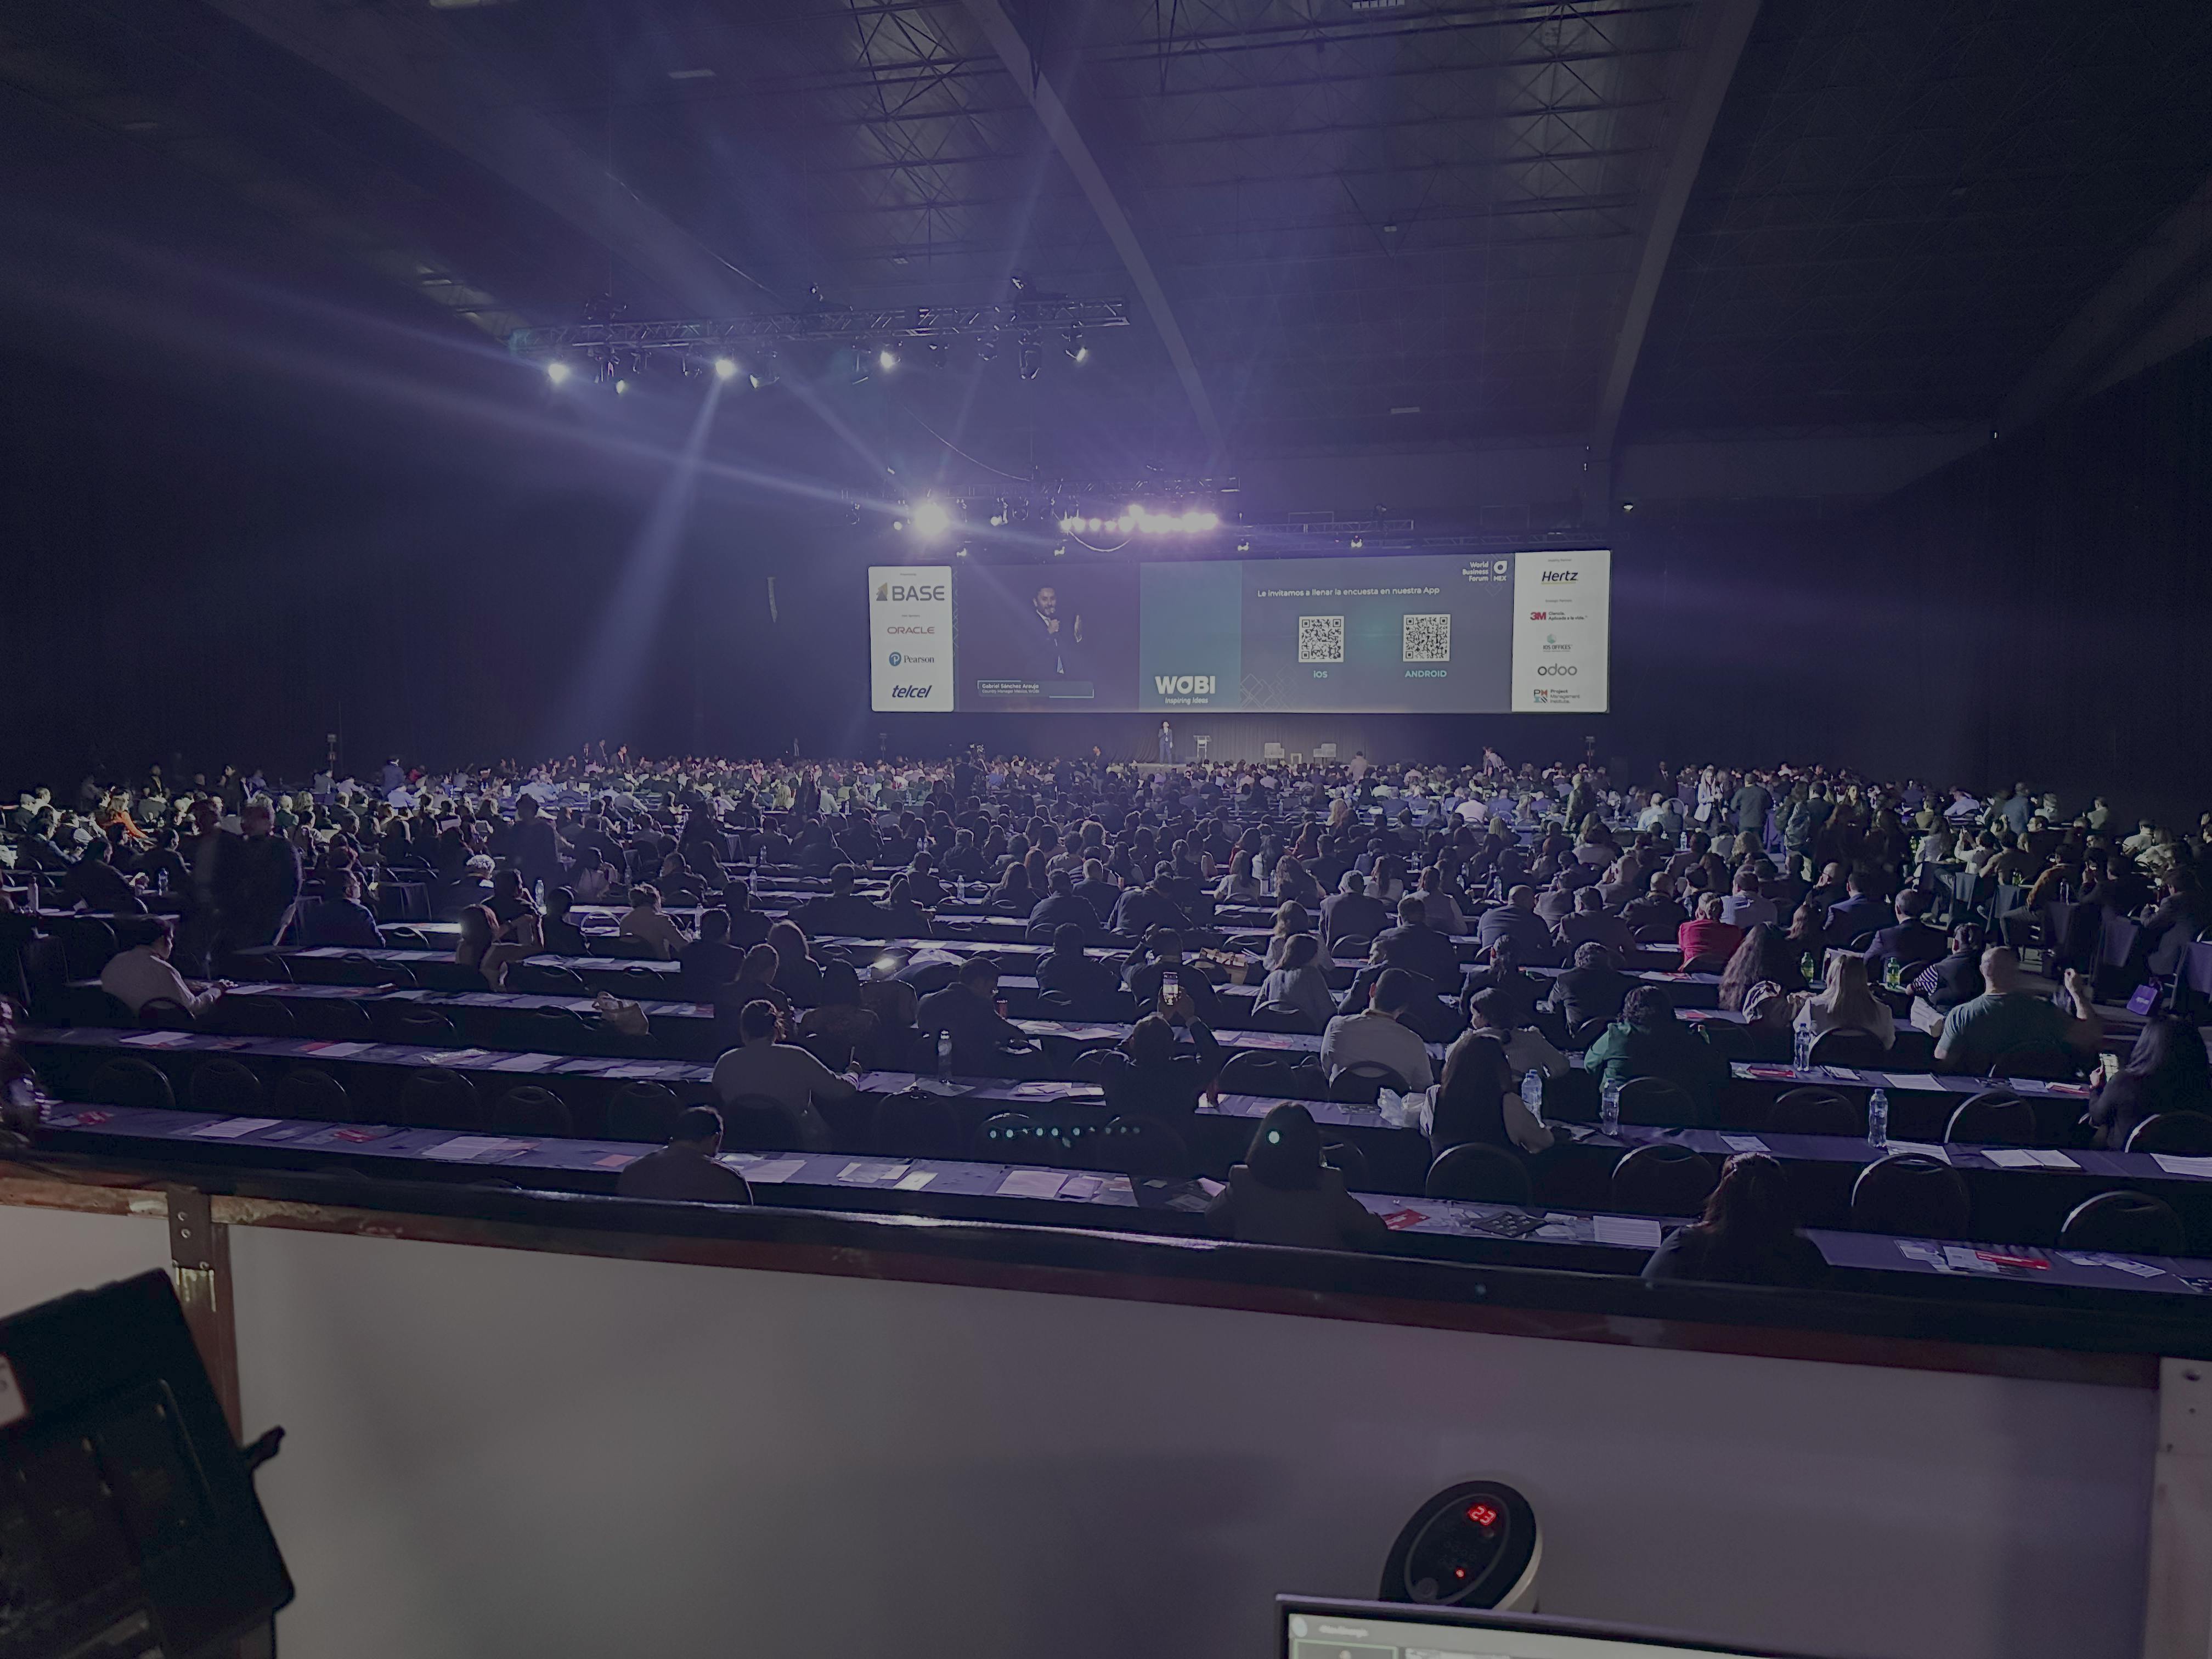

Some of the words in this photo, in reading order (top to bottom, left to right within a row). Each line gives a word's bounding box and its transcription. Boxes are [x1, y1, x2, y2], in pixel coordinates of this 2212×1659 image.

[1542, 571, 1578, 582] Hertz
[892, 585, 945, 601] BASE
[1530, 612, 1547, 620] 3M
[904, 655, 934, 663] Pearson
[1537, 663, 1577, 676] odoo
[1155, 675, 1216, 694] WOBI
[892, 685, 932, 698] telcel
[1471, 1506, 1496, 1525] 23
